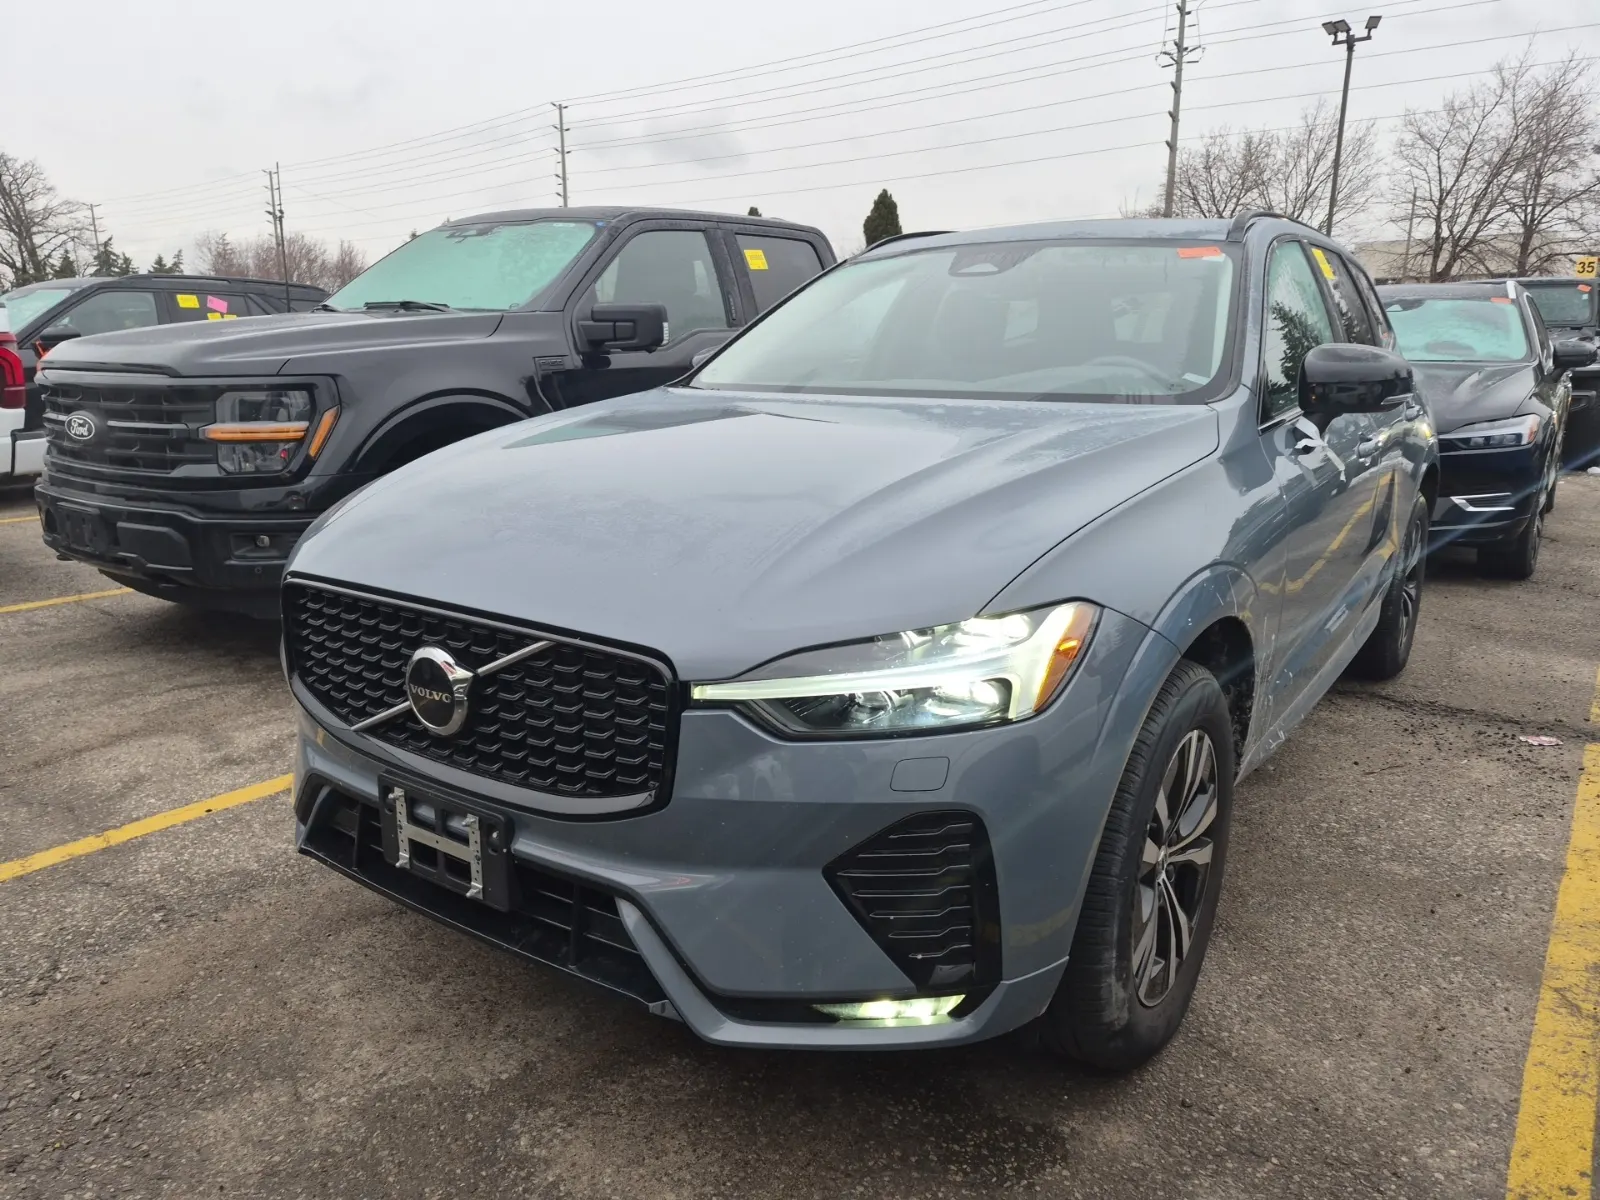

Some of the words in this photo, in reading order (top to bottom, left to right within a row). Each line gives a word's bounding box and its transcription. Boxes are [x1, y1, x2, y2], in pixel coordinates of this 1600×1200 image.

[1577, 261, 1596, 274] 35
[70, 418, 89, 436] Ford
[410, 683, 452, 703] VOLVO
